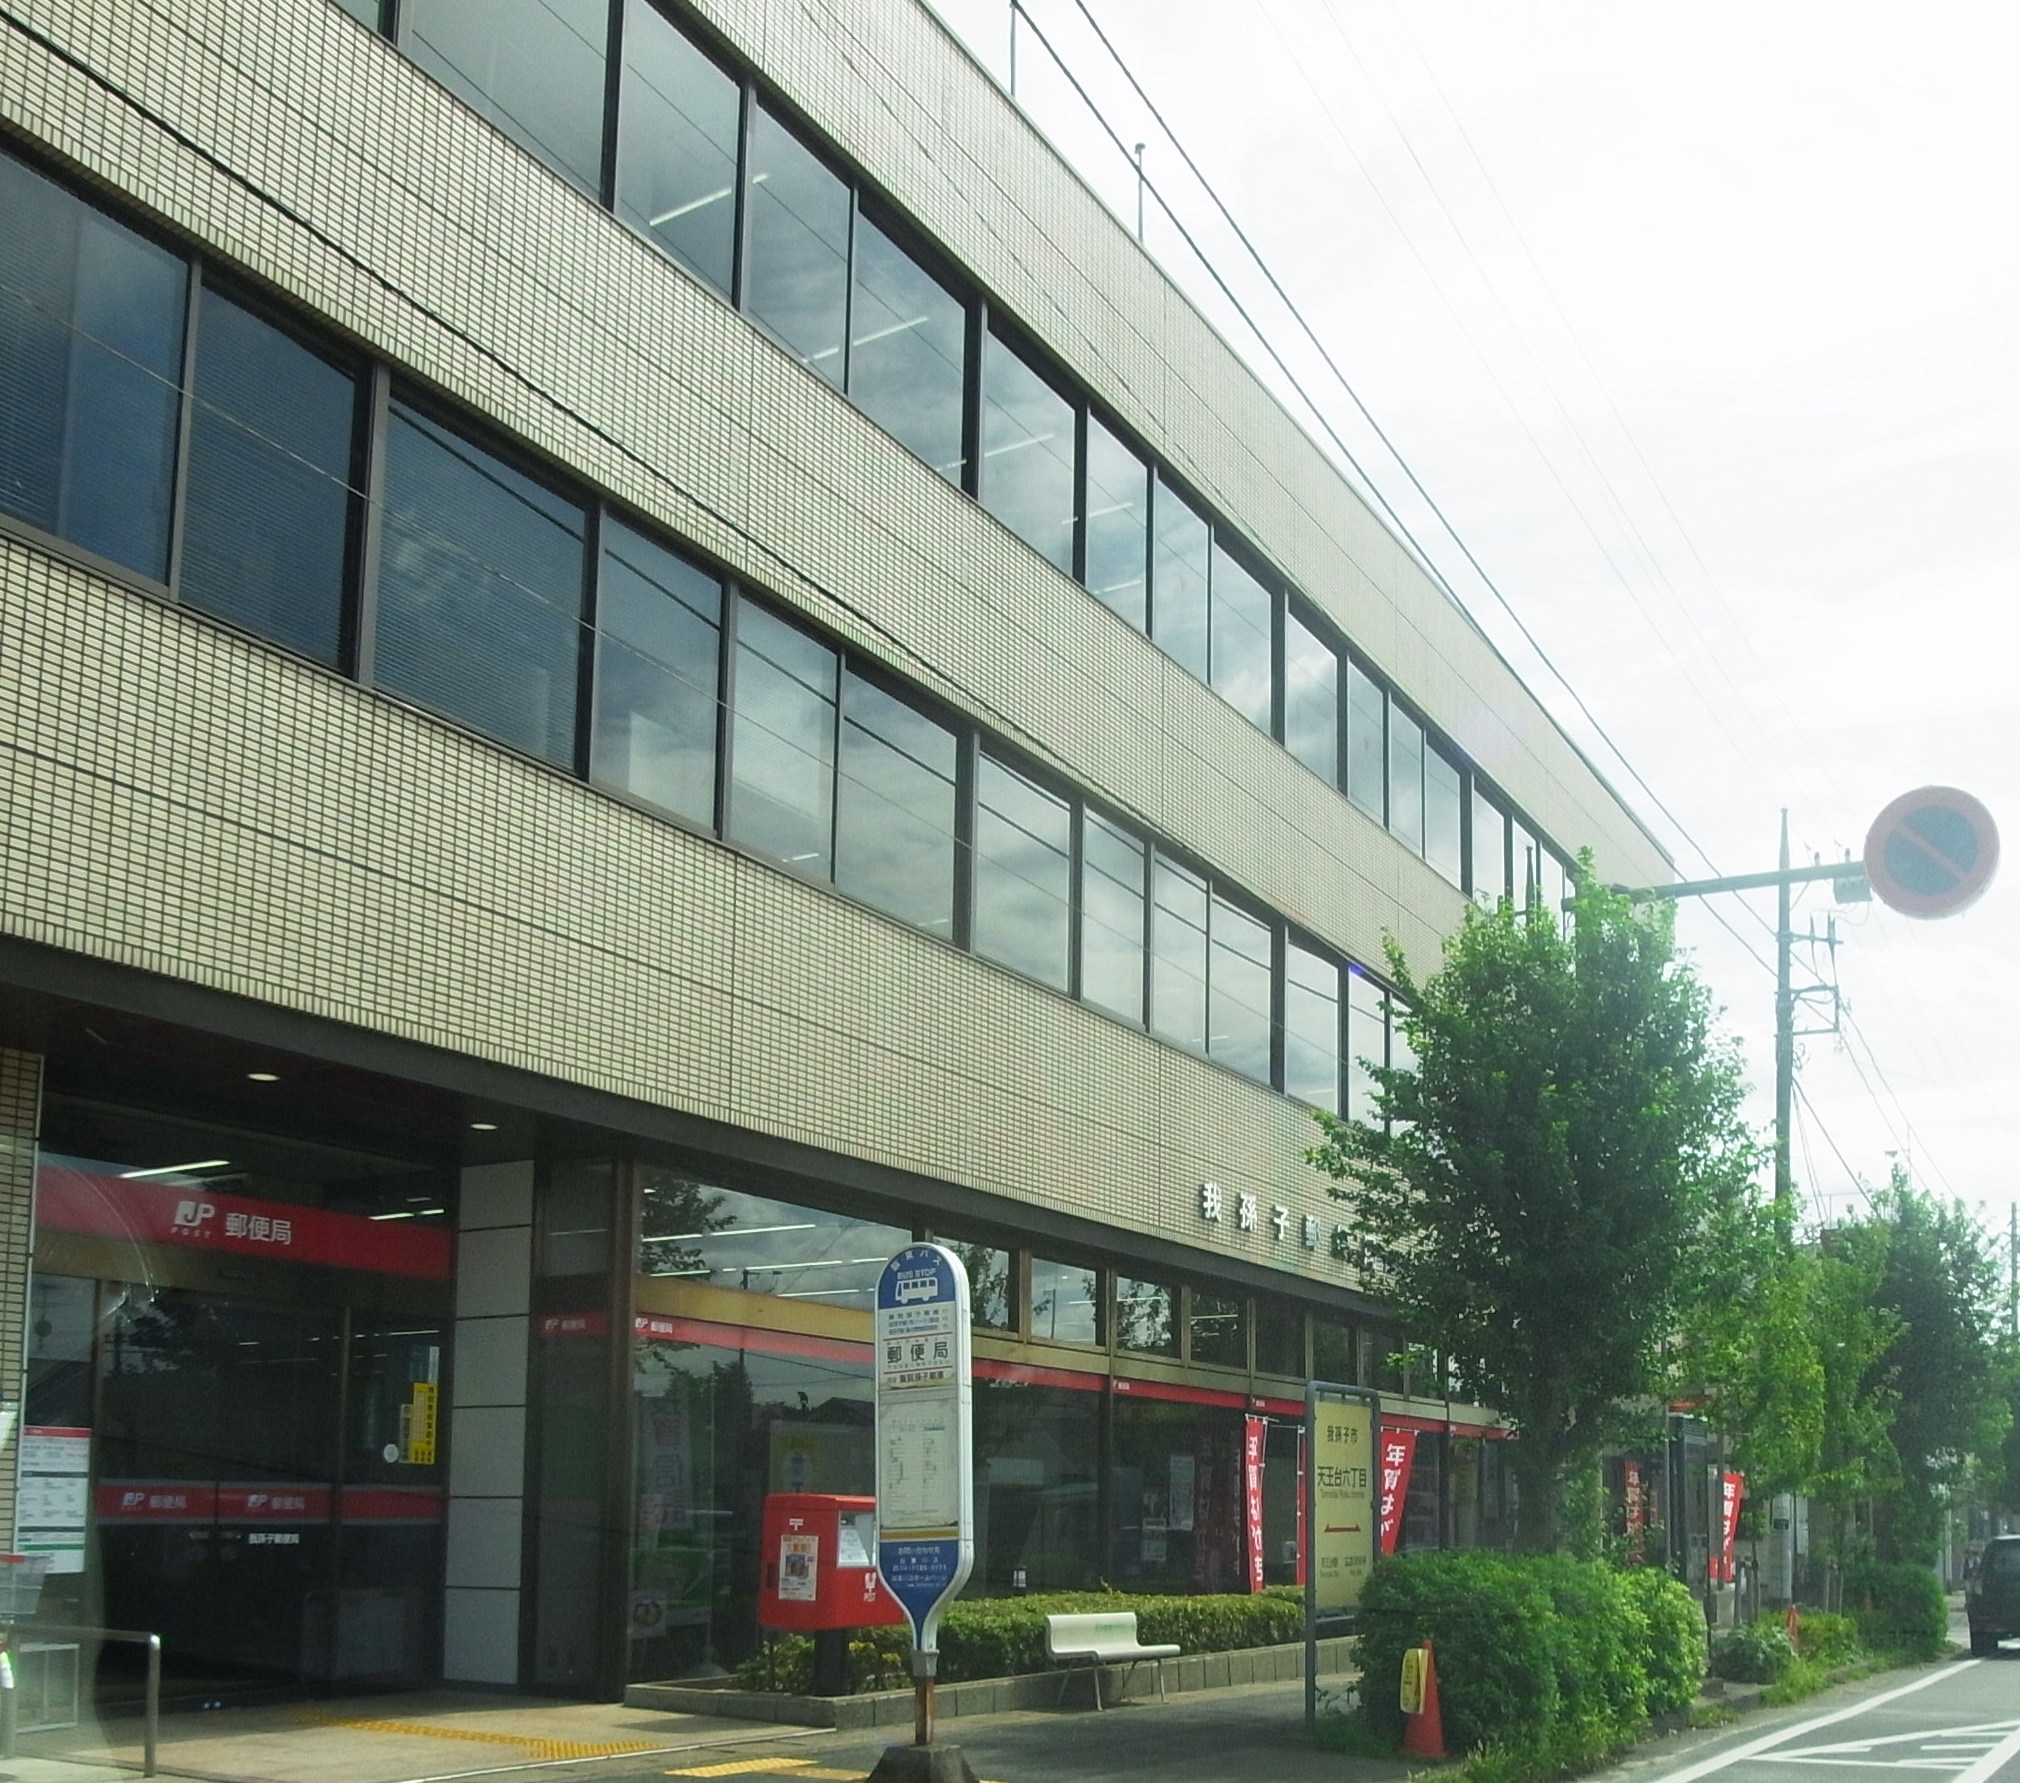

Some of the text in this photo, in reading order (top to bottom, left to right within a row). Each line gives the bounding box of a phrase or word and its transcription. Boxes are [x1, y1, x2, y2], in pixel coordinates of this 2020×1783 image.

[225, 1212, 292, 1245] 郵便局
[887, 1341, 948, 1364] 郵便局
[1326, 1425, 1358, 1443] 我孫子市
[1317, 1466, 1367, 1488] 天王台六丁目
